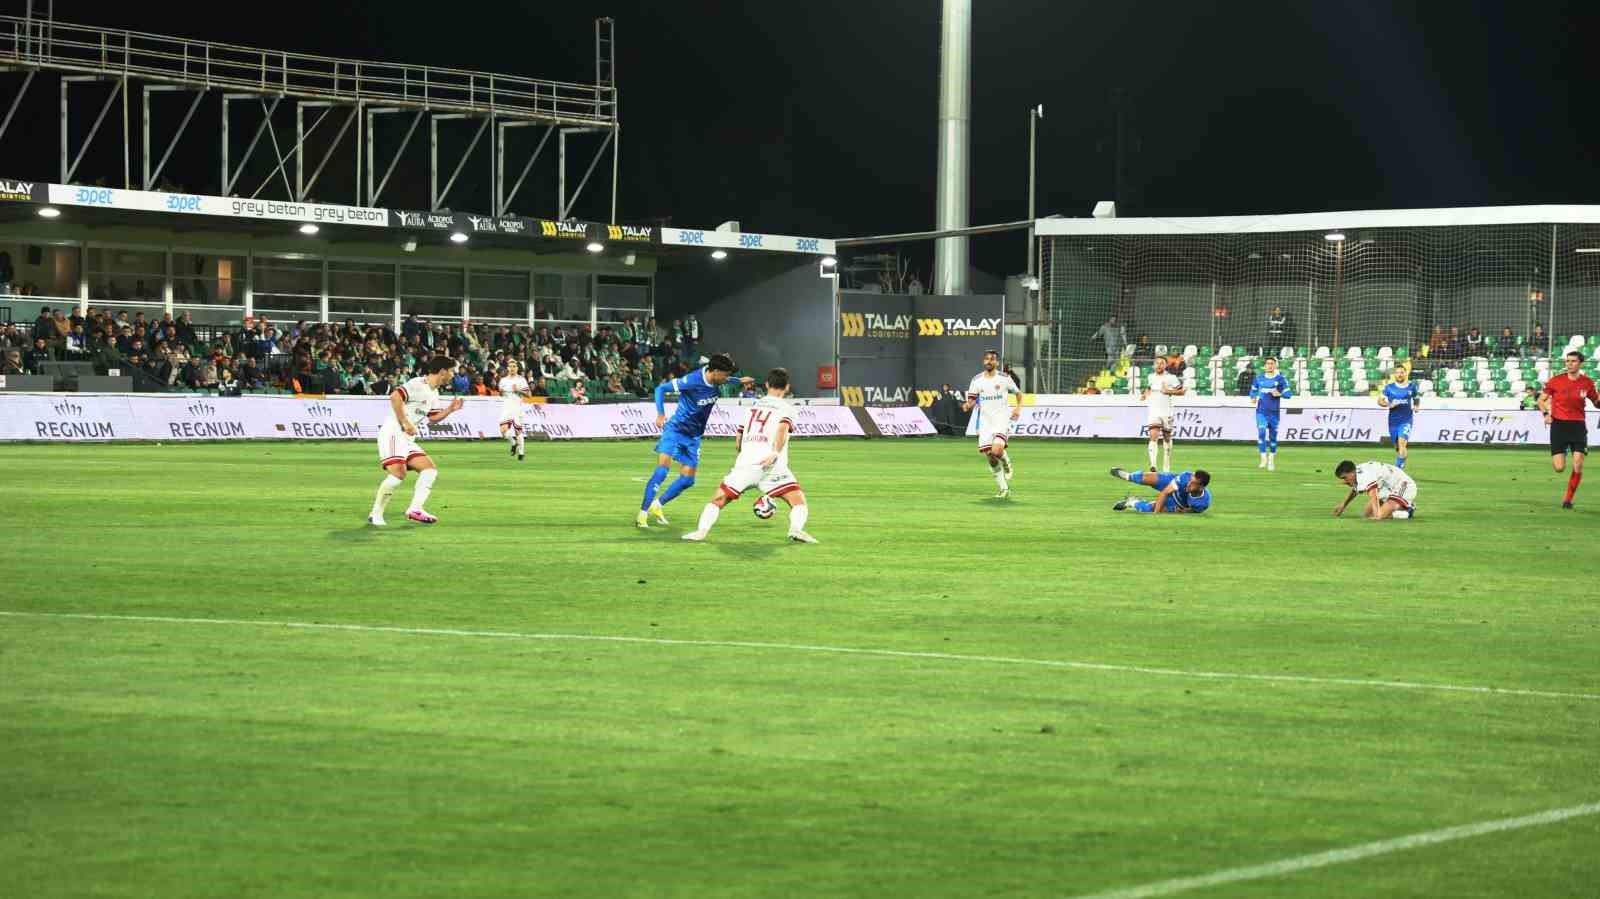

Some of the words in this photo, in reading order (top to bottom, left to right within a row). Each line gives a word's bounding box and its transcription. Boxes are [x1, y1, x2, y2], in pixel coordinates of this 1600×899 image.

[0, 182, 34, 194] ALAY
[232, 201, 264, 216] grey
[267, 202, 306, 216] beton
[314, 207, 344, 221] grey
[347, 208, 384, 221] beton
[556, 222, 587, 233] TALAY
[621, 226, 652, 236] TALAY
[865, 313, 912, 330] TALAY
[943, 318, 1001, 330] TALAY
[864, 386, 912, 402] TALAY
[747, 408, 772, 433] 14
[35, 421, 114, 437] REGNUM
[169, 422, 245, 436] REGNUM
[292, 422, 361, 437] REGNUM
[879, 423, 921, 433] EGNUM
[1286, 427, 1372, 440] REGNUM
[1438, 429, 1530, 442] REGNUM
